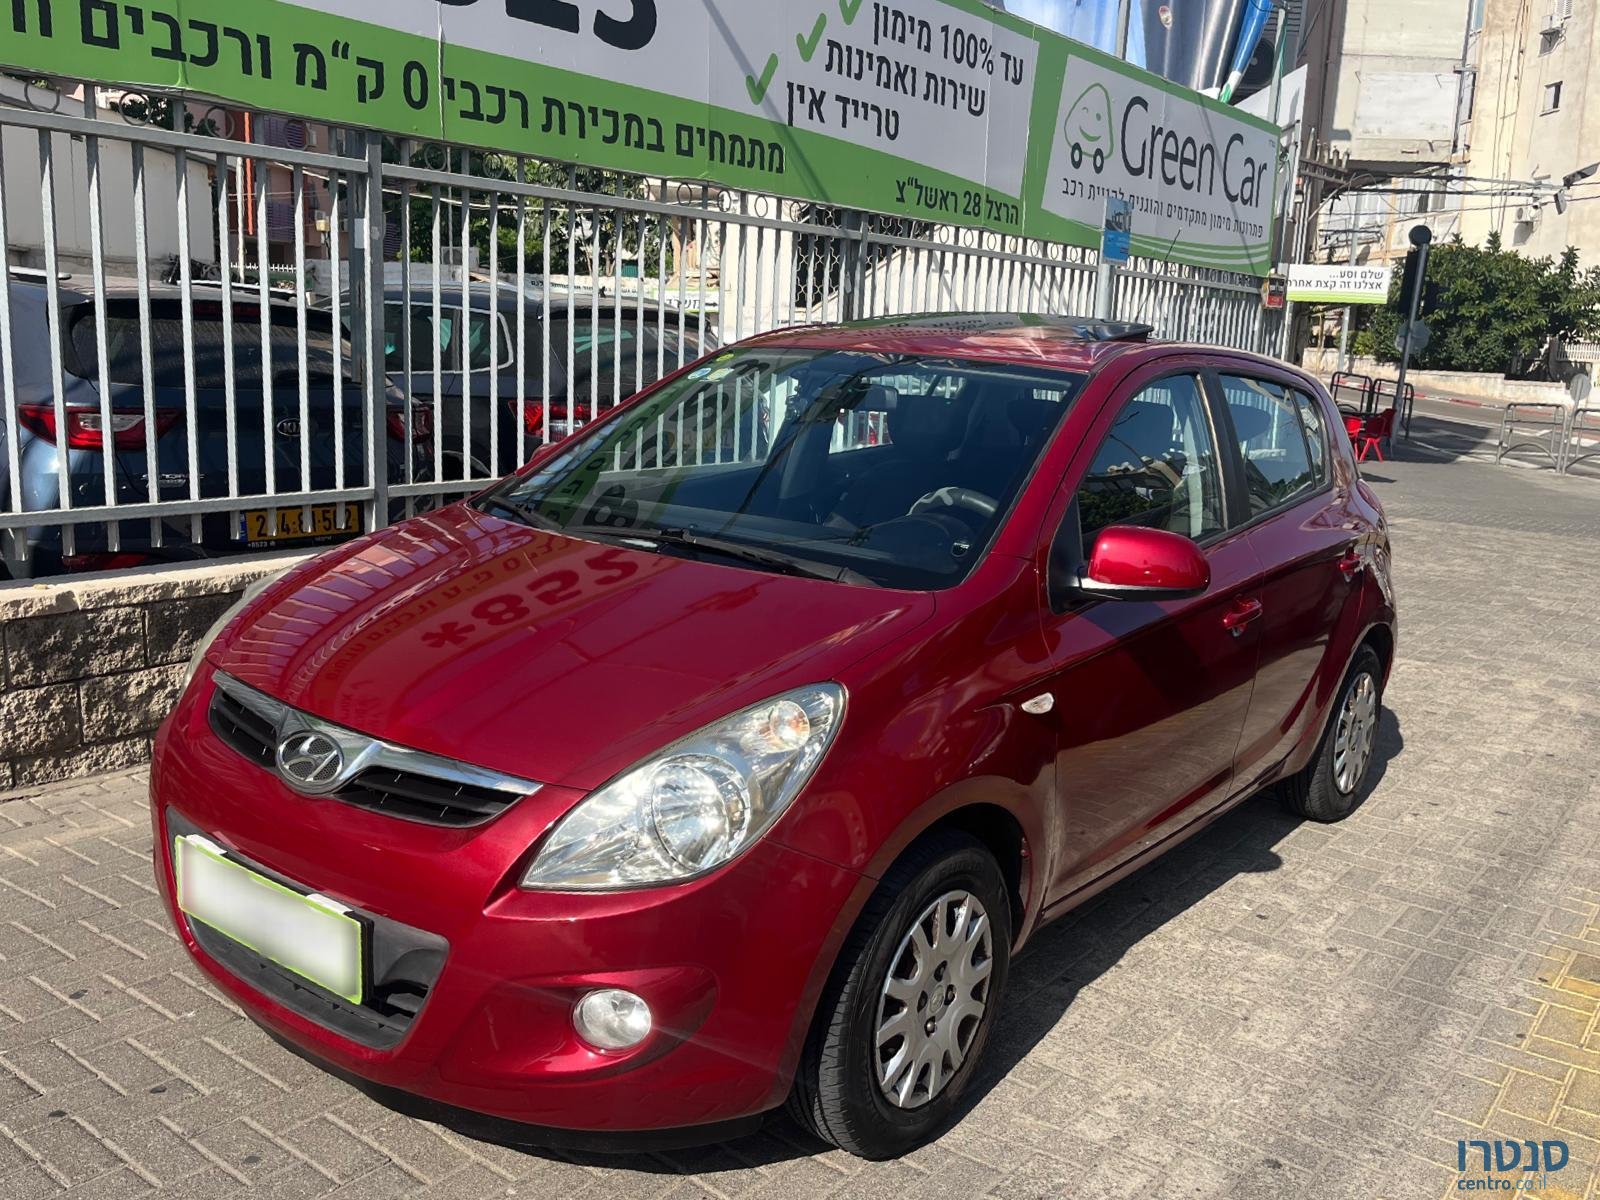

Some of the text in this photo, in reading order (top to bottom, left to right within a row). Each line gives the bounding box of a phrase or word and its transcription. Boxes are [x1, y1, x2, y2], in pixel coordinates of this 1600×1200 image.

[80, 0, 272, 80] ורכבים
[872, 1, 1024, 85] עד 100% מימון
[443, 77, 530, 130] רכבי
[824, 39, 986, 117] שירות ואמינות
[541, 96, 665, 153] במכירת
[786, 81, 899, 141] טרייד אין
[675, 122, 785, 174] מתמחים
[1120, 95, 1268, 209] Green Car
[962, 190, 981, 216] 28
[984, 197, 1019, 226] הרצל
[1062, 177, 1084, 199] רכב
[1315, 279, 1337, 290] קצת
[1340, 280, 1352, 289] זה
